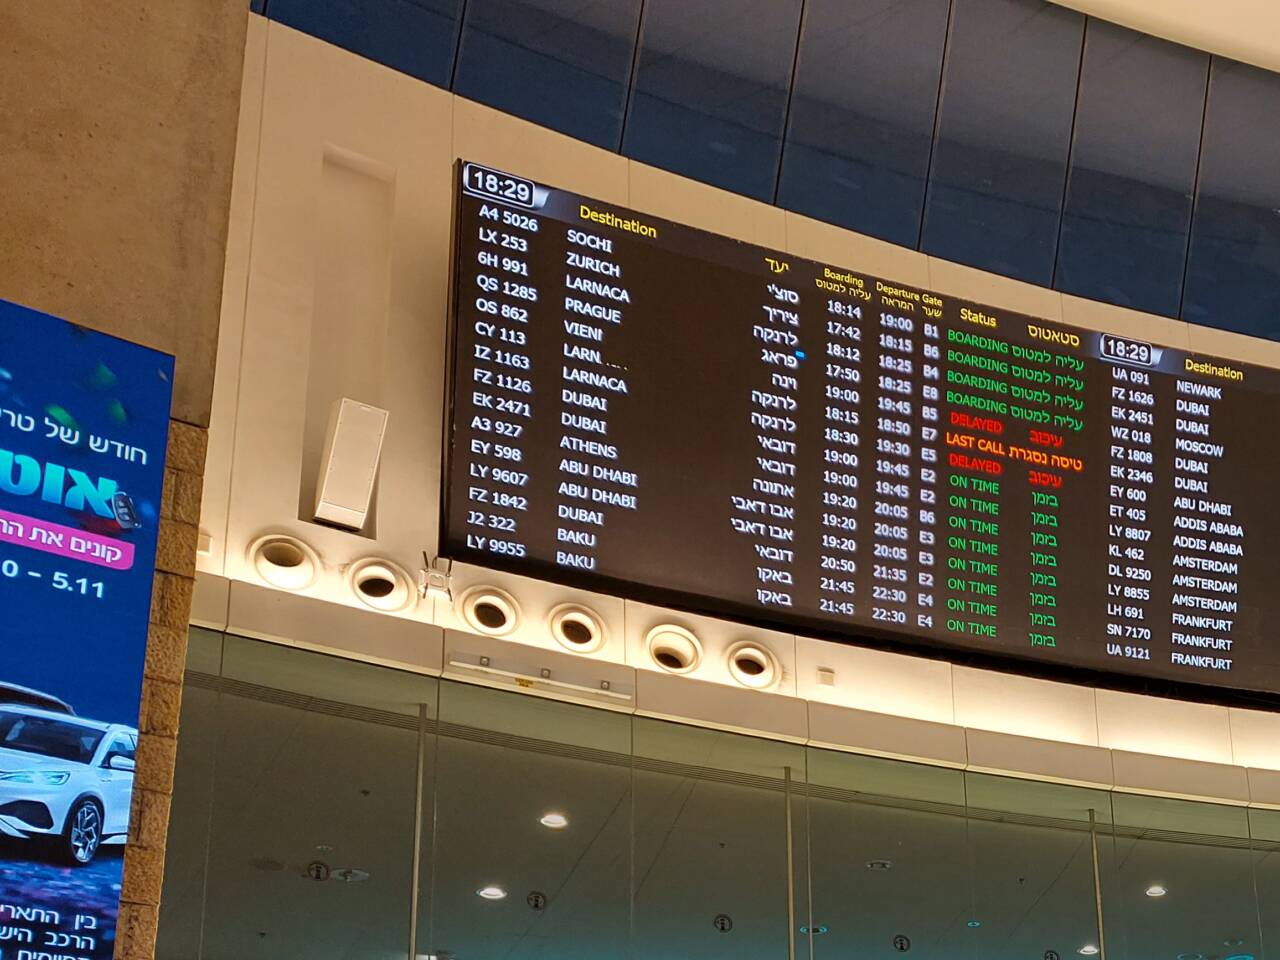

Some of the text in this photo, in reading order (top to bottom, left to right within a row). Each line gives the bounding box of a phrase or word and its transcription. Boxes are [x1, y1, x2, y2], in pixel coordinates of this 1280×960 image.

[472, 170, 530, 202] 18:29
[479, 205, 538, 231] A4 5026
[579, 204, 657, 238] Destination
[567, 229, 612, 252] SOCHI
[566, 252, 621, 278] ZURICH
[566, 275, 630, 302] LARNACA
[824, 269, 864, 288] Boarding
[876, 282, 942, 307] Departure Gate
[564, 298, 622, 323] PRAGUE
[763, 306, 799, 326] ציריך
[827, 300, 861, 319] 18:14
[960, 308, 996, 327] Status
[879, 312, 912, 331] 19:00
[948, 330, 1009, 353] BOARDING
[1028, 324, 1080, 347] סטאטוס
[1011, 346, 1084, 371] עליה למטוס
[1107, 339, 1148, 362] 18:29
[563, 366, 628, 394] LARNACA
[1185, 358, 1244, 380] Destination
[562, 389, 608, 411] DUBAI
[1176, 380, 1222, 400] NEWARK
[44, 417, 80, 444] של
[951, 411, 1002, 432] DELAYED
[89, 434, 146, 465] חודש
[560, 436, 618, 459] ATHENS
[946, 432, 1005, 455] LAST CALL
[1176, 438, 1224, 458] MOSCOW
[1009, 446, 1083, 471] טיסה נסגרת
[560, 459, 638, 487] ABU DHABI
[949, 474, 999, 495] ON TIME
[558, 505, 604, 525] DUBAI
[1174, 516, 1244, 537] ADDIS ABABA
[28, 527, 122, 562] קונים את
[466, 534, 526, 557] LY 9955
[557, 528, 596, 547] BAKU
[1173, 554, 1238, 574] AMSTERDAM
[53, 571, 104, 599] 5.11
[1172, 574, 1238, 594] AMSTERDAM
[1172, 613, 1232, 632] FRANKFURT
[1106, 643, 1150, 660] UA 9121
[74, 915, 96, 930] בין
[44, 931, 94, 950] הרכב
